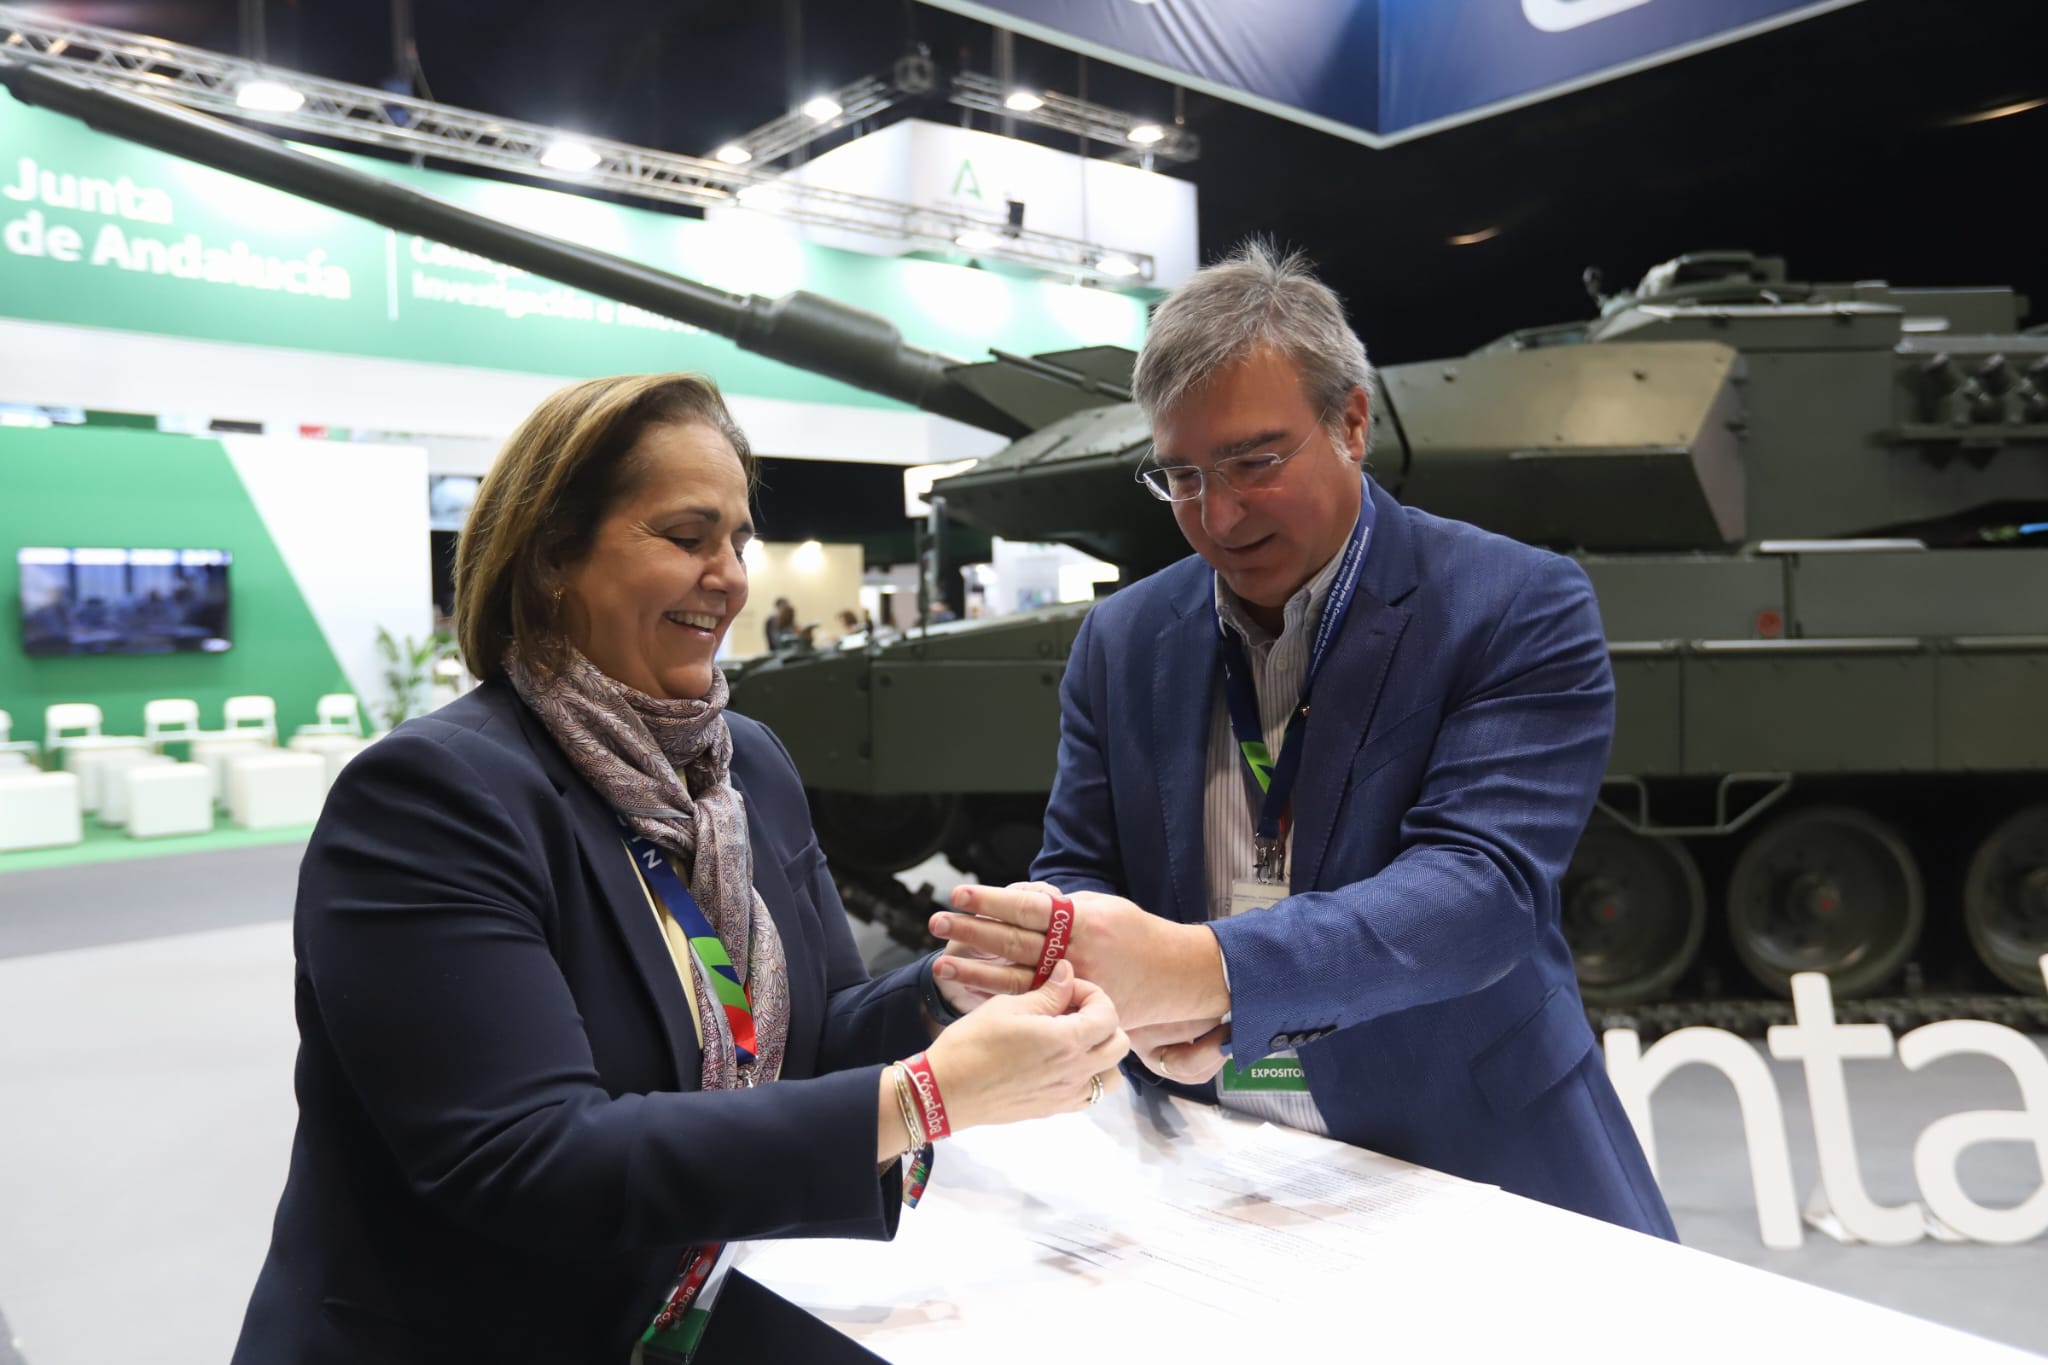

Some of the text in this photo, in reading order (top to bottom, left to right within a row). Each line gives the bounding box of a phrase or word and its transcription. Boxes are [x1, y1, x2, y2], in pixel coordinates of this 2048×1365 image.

[2, 156, 173, 224] Junta
[4, 208, 352, 300] de Andalucía
[1251, 1067, 1305, 1079] EXPOSITO
